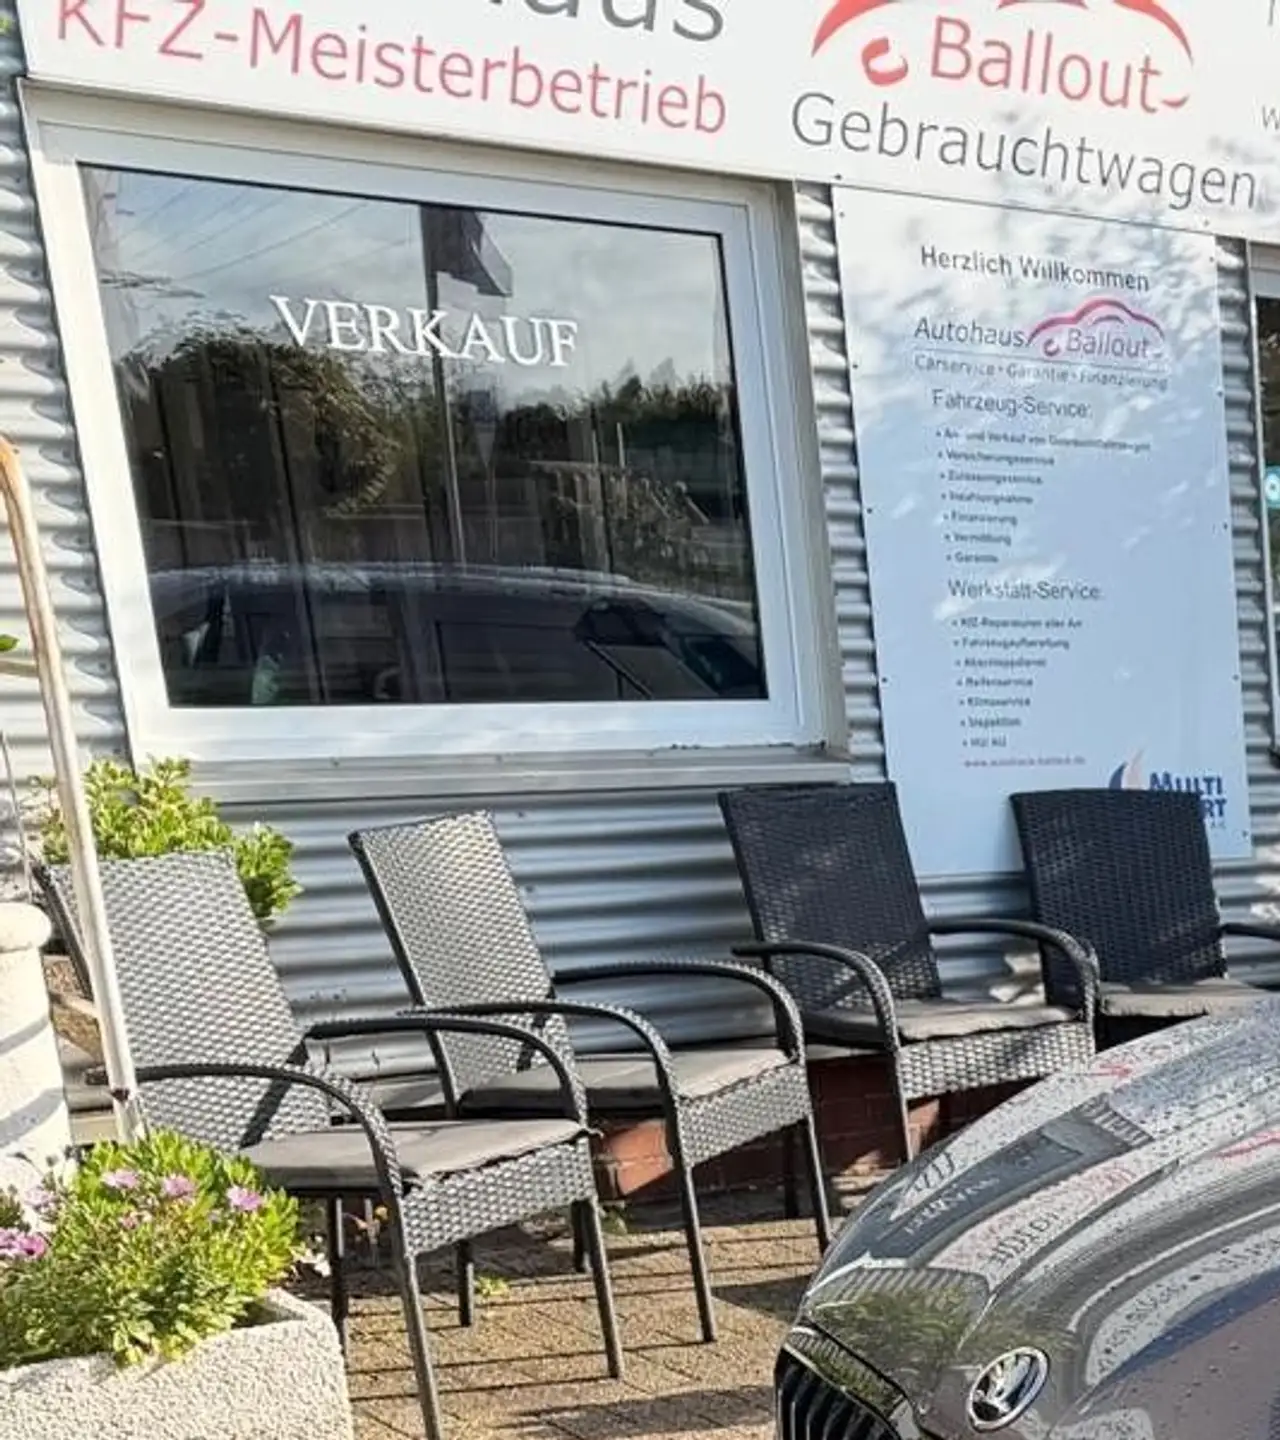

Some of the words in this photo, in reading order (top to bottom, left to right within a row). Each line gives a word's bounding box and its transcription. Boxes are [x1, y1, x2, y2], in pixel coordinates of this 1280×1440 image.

[56, 0, 728, 134] KFZ-Meisterbetrieb
[930, 14, 1164, 114] Ballout
[790, 91, 1256, 210] Gebrauchtwagen
[920, 245, 1012, 277] Herzlich
[1019, 257, 1150, 292] Willkommen
[271, 295, 578, 367] VERKAUF
[913, 316, 1025, 348] Autohaus
[1065, 328, 1150, 359] Ballout
